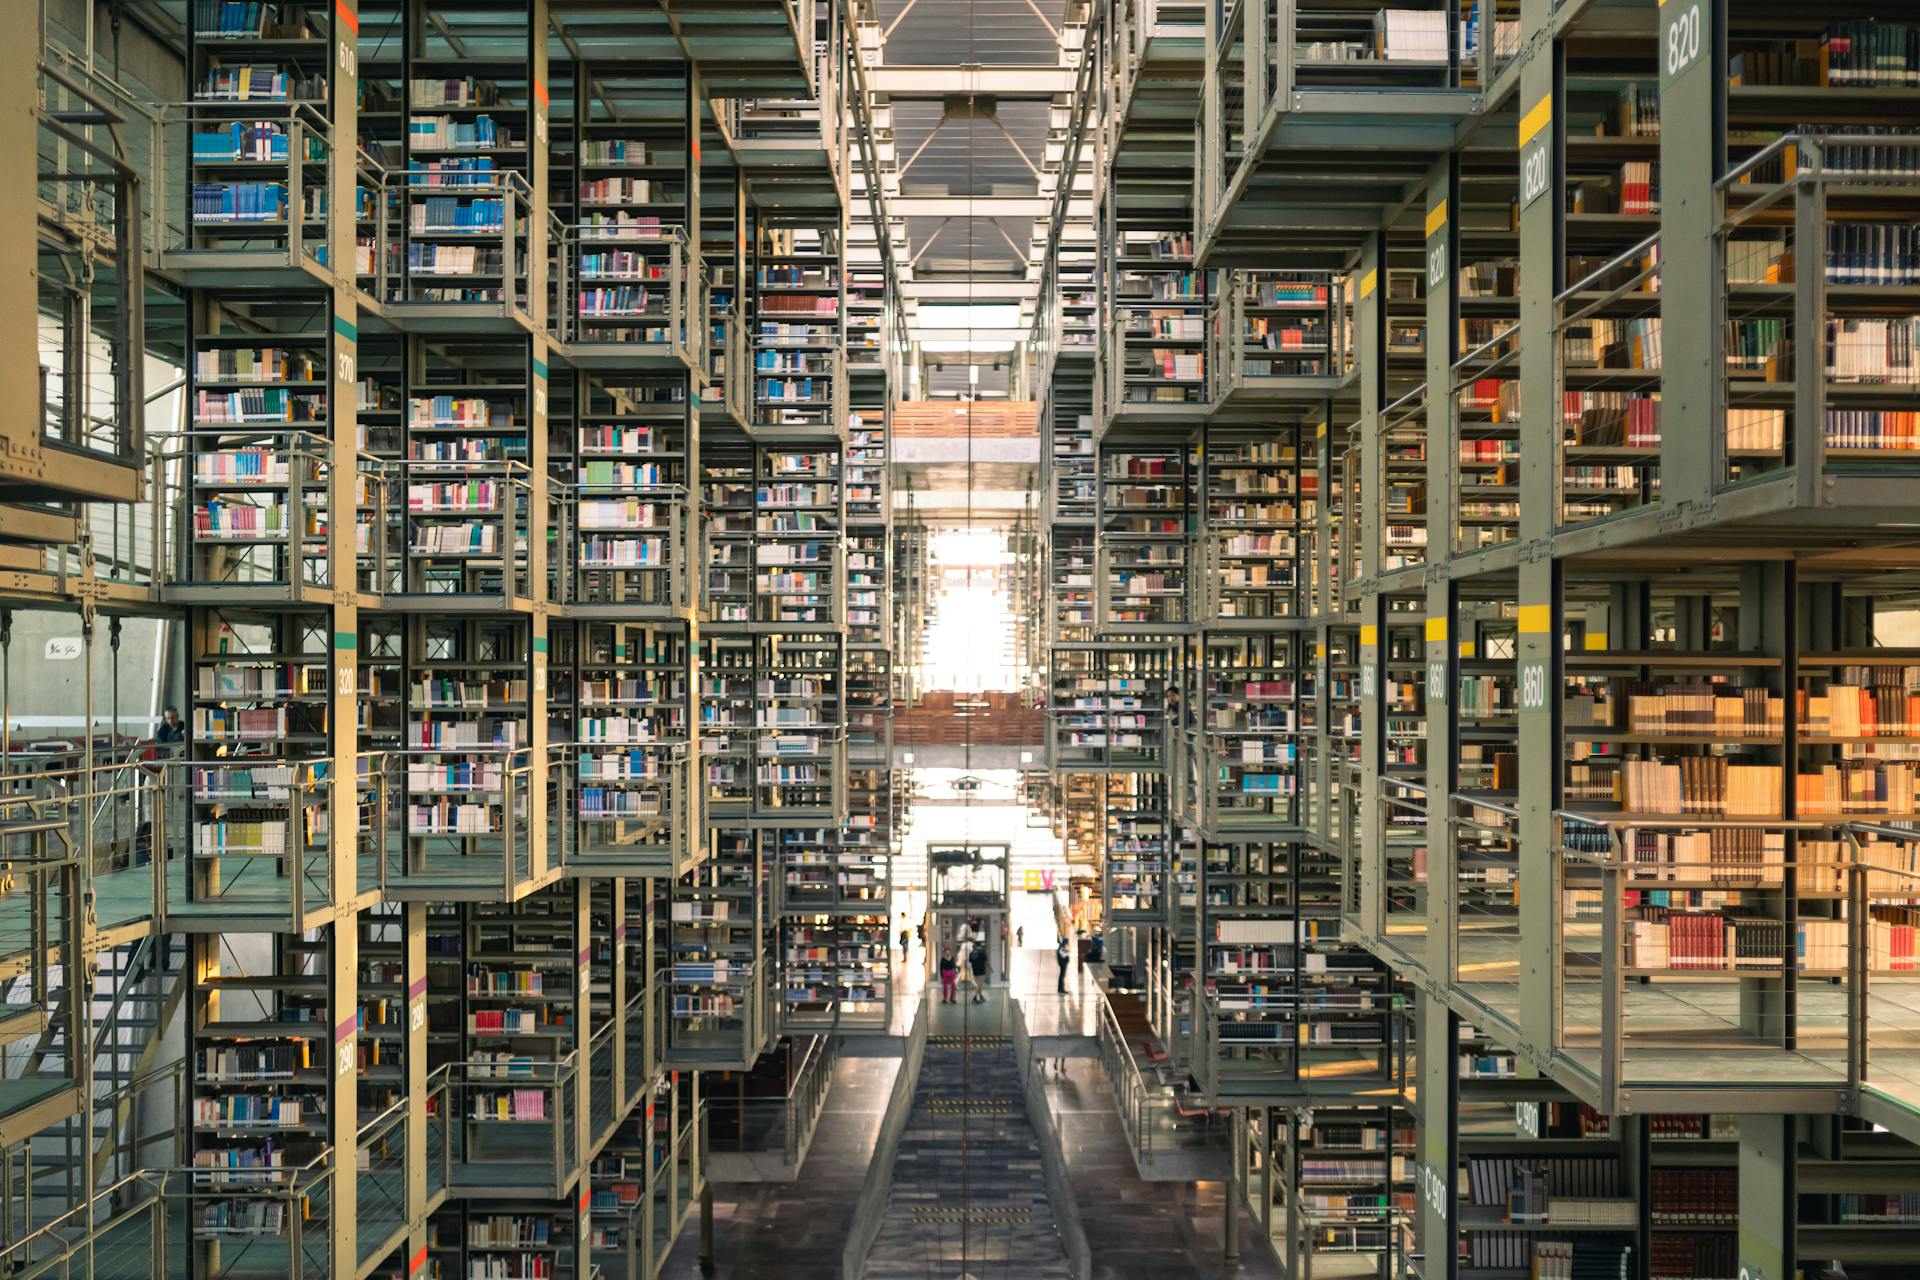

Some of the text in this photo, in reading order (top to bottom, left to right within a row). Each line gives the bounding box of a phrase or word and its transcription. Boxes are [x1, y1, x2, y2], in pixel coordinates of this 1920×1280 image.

[1668, 4, 1699, 75] 820
[340, 41, 354, 77] 610
[1525, 146, 1545, 200] 820
[1430, 243, 1444, 286] 820
[338, 352, 353, 383] 370
[339, 667, 353, 695] 320
[536, 667, 545, 691] 320
[1363, 665, 1374, 696] 860
[1430, 663, 1444, 698] 860
[1524, 664, 1544, 707] 860
[412, 1002, 424, 1032] 290
[339, 1042, 353, 1075] 290
[1524, 1101, 1539, 1139] 900
[1424, 1165, 1447, 1221] C 900
